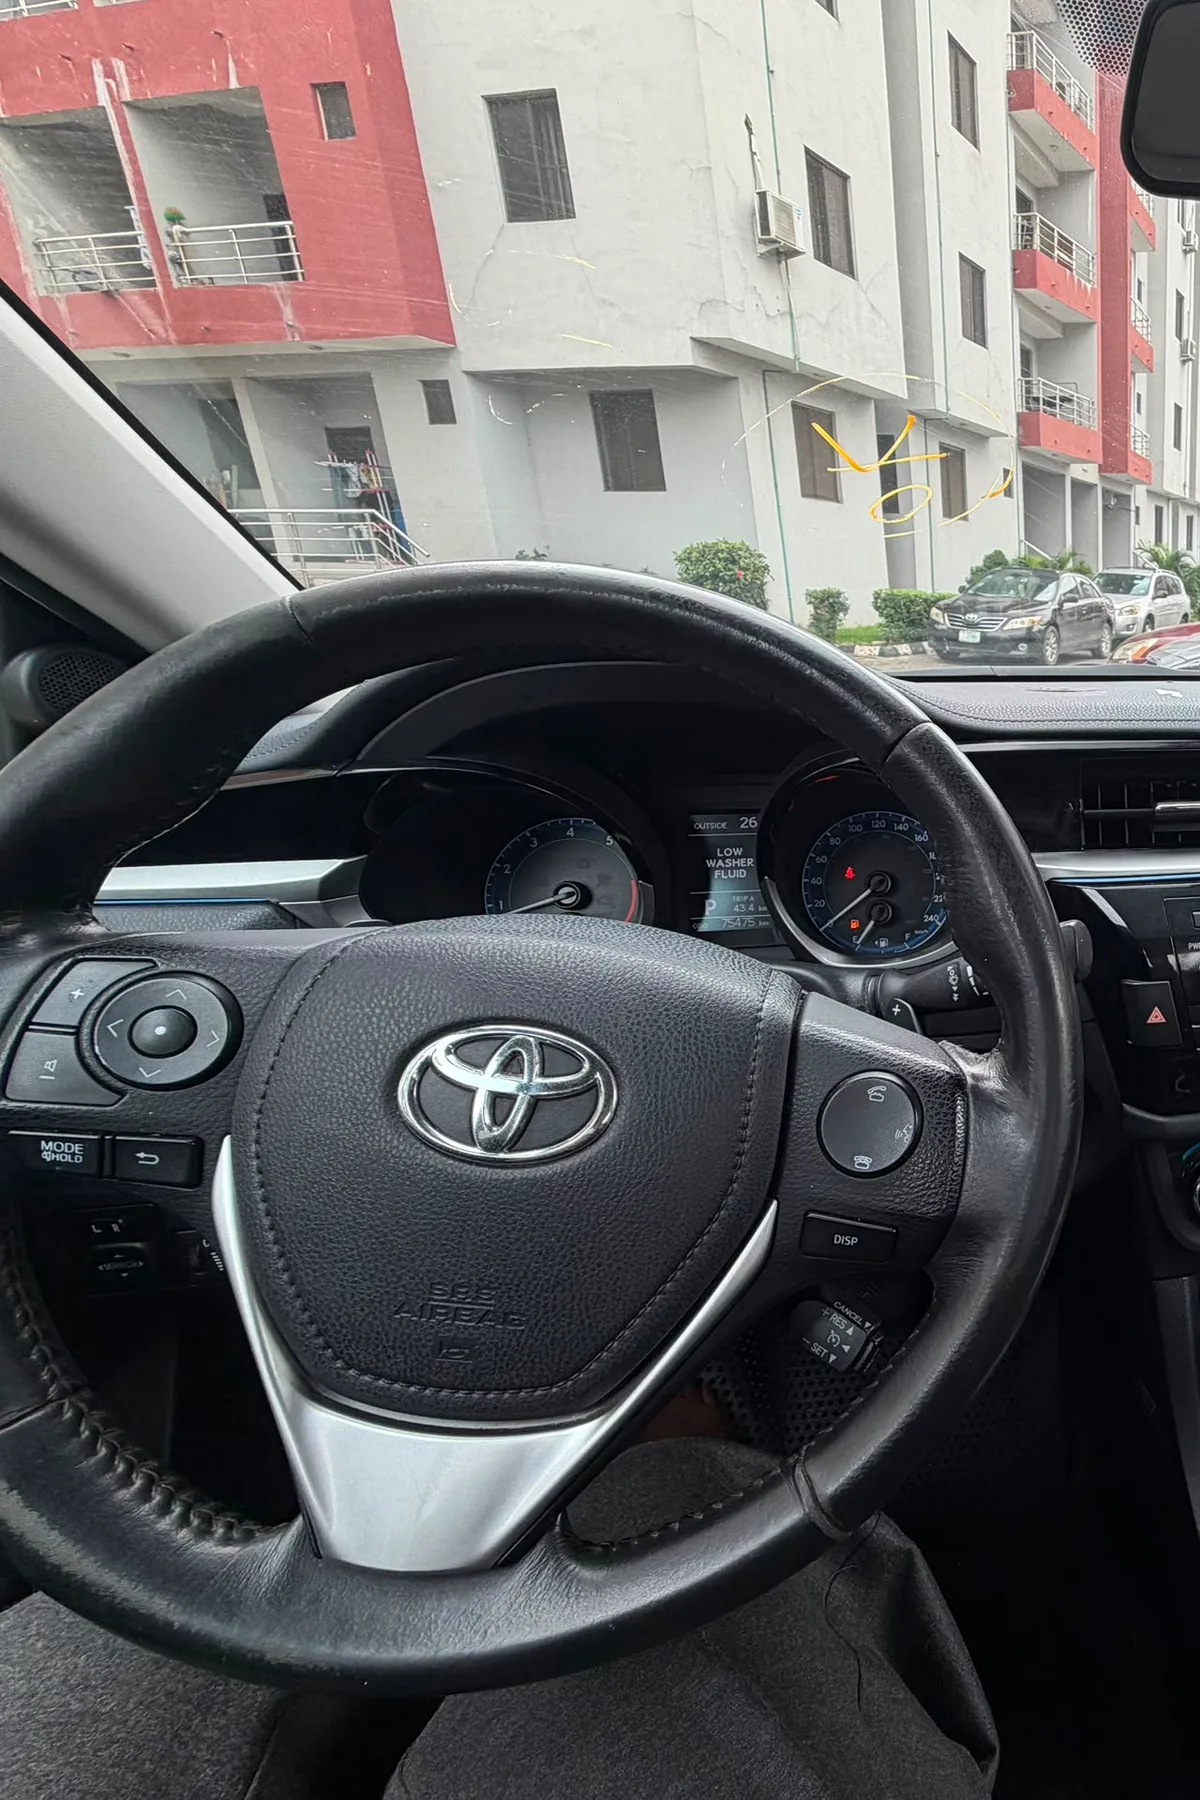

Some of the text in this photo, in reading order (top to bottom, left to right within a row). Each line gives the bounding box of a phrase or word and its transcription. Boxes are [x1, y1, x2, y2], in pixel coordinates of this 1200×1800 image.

[693, 816, 758, 830] OUTSIDE 26
[848, 824, 863, 832] 100
[871, 820, 886, 828] 120
[894, 823, 909, 832] 140
[566, 827, 575, 838] 4
[914, 833, 929, 842] 160
[530, 837, 538, 848] 3
[605, 835, 614, 846] 5
[829, 837, 841, 846] 80
[716, 847, 743, 857] LOW
[706, 858, 755, 868] WASHER
[815, 855, 828, 864] 60
[503, 864, 511, 875] 2
[714, 869, 747, 879] FLUID
[811, 876, 822, 885] 40
[705, 899, 717, 916] P
[733, 903, 755, 913] 43.4
[814, 899, 826, 908] 20
[721, 917, 756, 928] 75475
[923, 914, 939, 923] 240
[905, 933, 911, 941] F
[40, 1140, 84, 1154] MODE
[52, 1152, 83, 1164] HOLD
[833, 1234, 859, 1247] DISP
[833, 1301, 863, 1324] CANCEL
